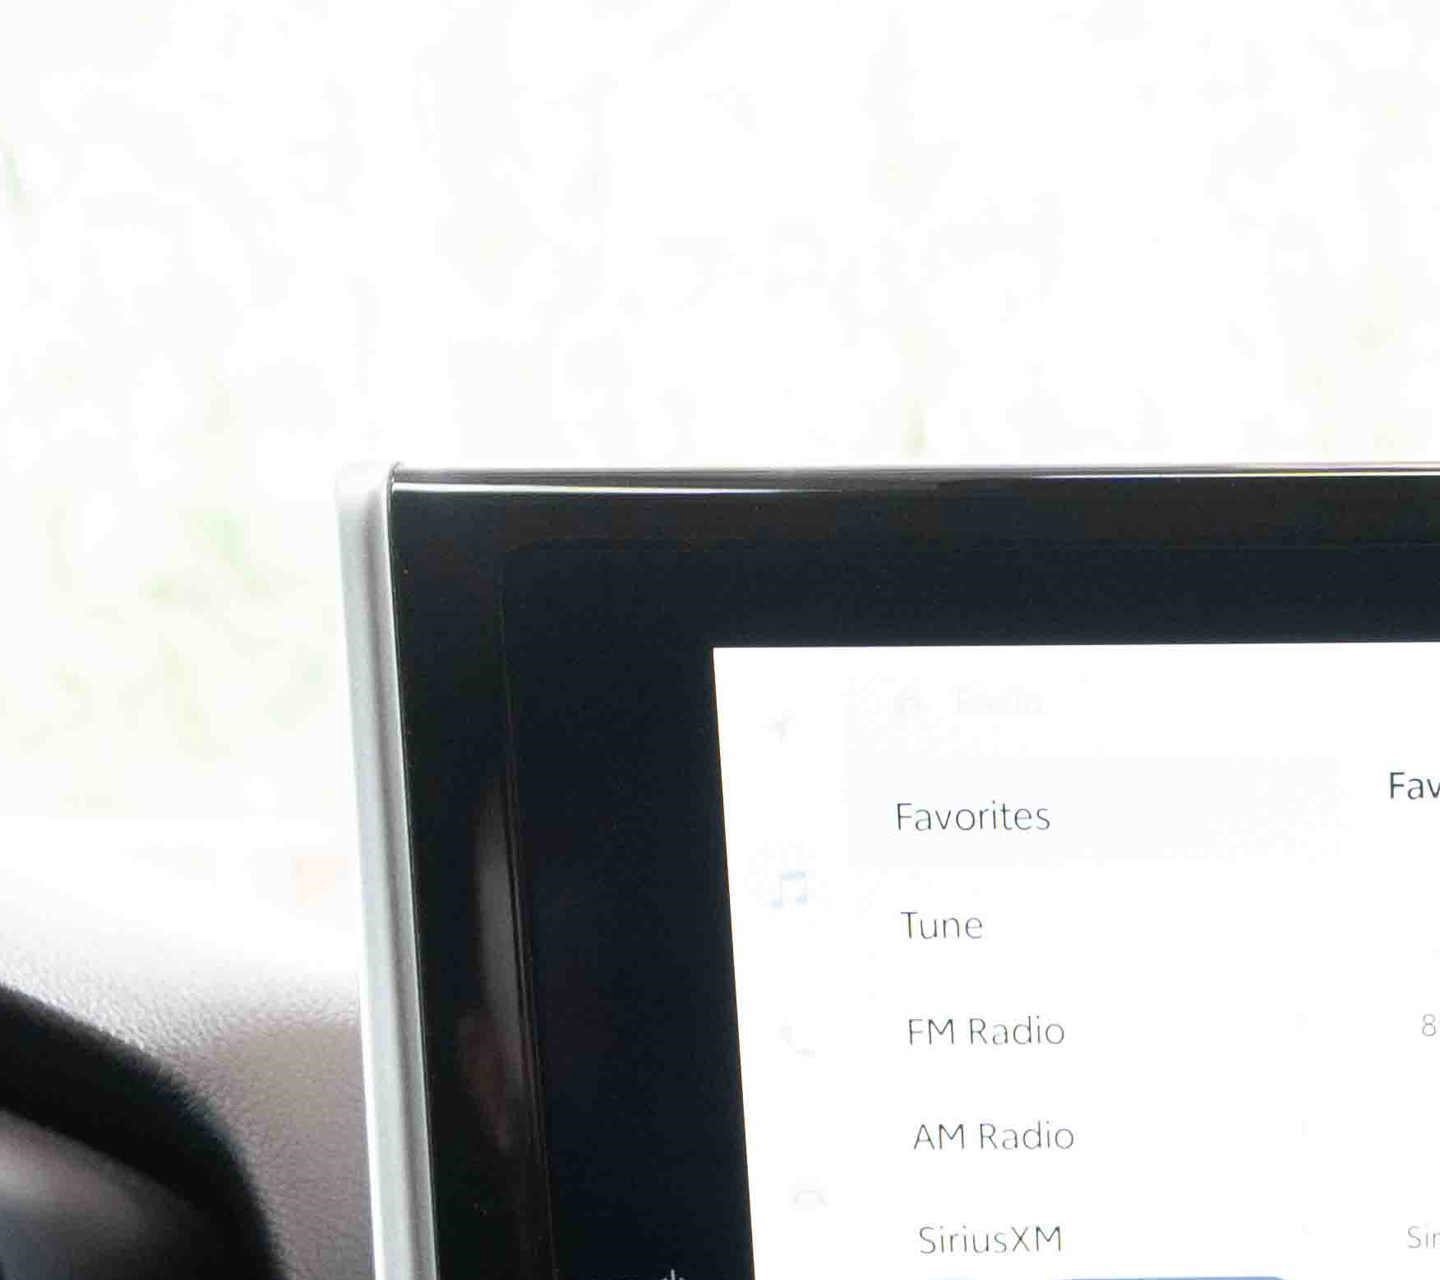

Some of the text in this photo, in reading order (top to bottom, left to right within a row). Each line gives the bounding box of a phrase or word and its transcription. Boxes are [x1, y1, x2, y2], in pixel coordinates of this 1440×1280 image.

[895, 800, 1051, 832] Favorites
[900, 912, 984, 940] Tune
[906, 1014, 1065, 1047] FM Radio
[912, 1119, 1075, 1151] AM Radio
[919, 1223, 1064, 1255] SiriusXM
